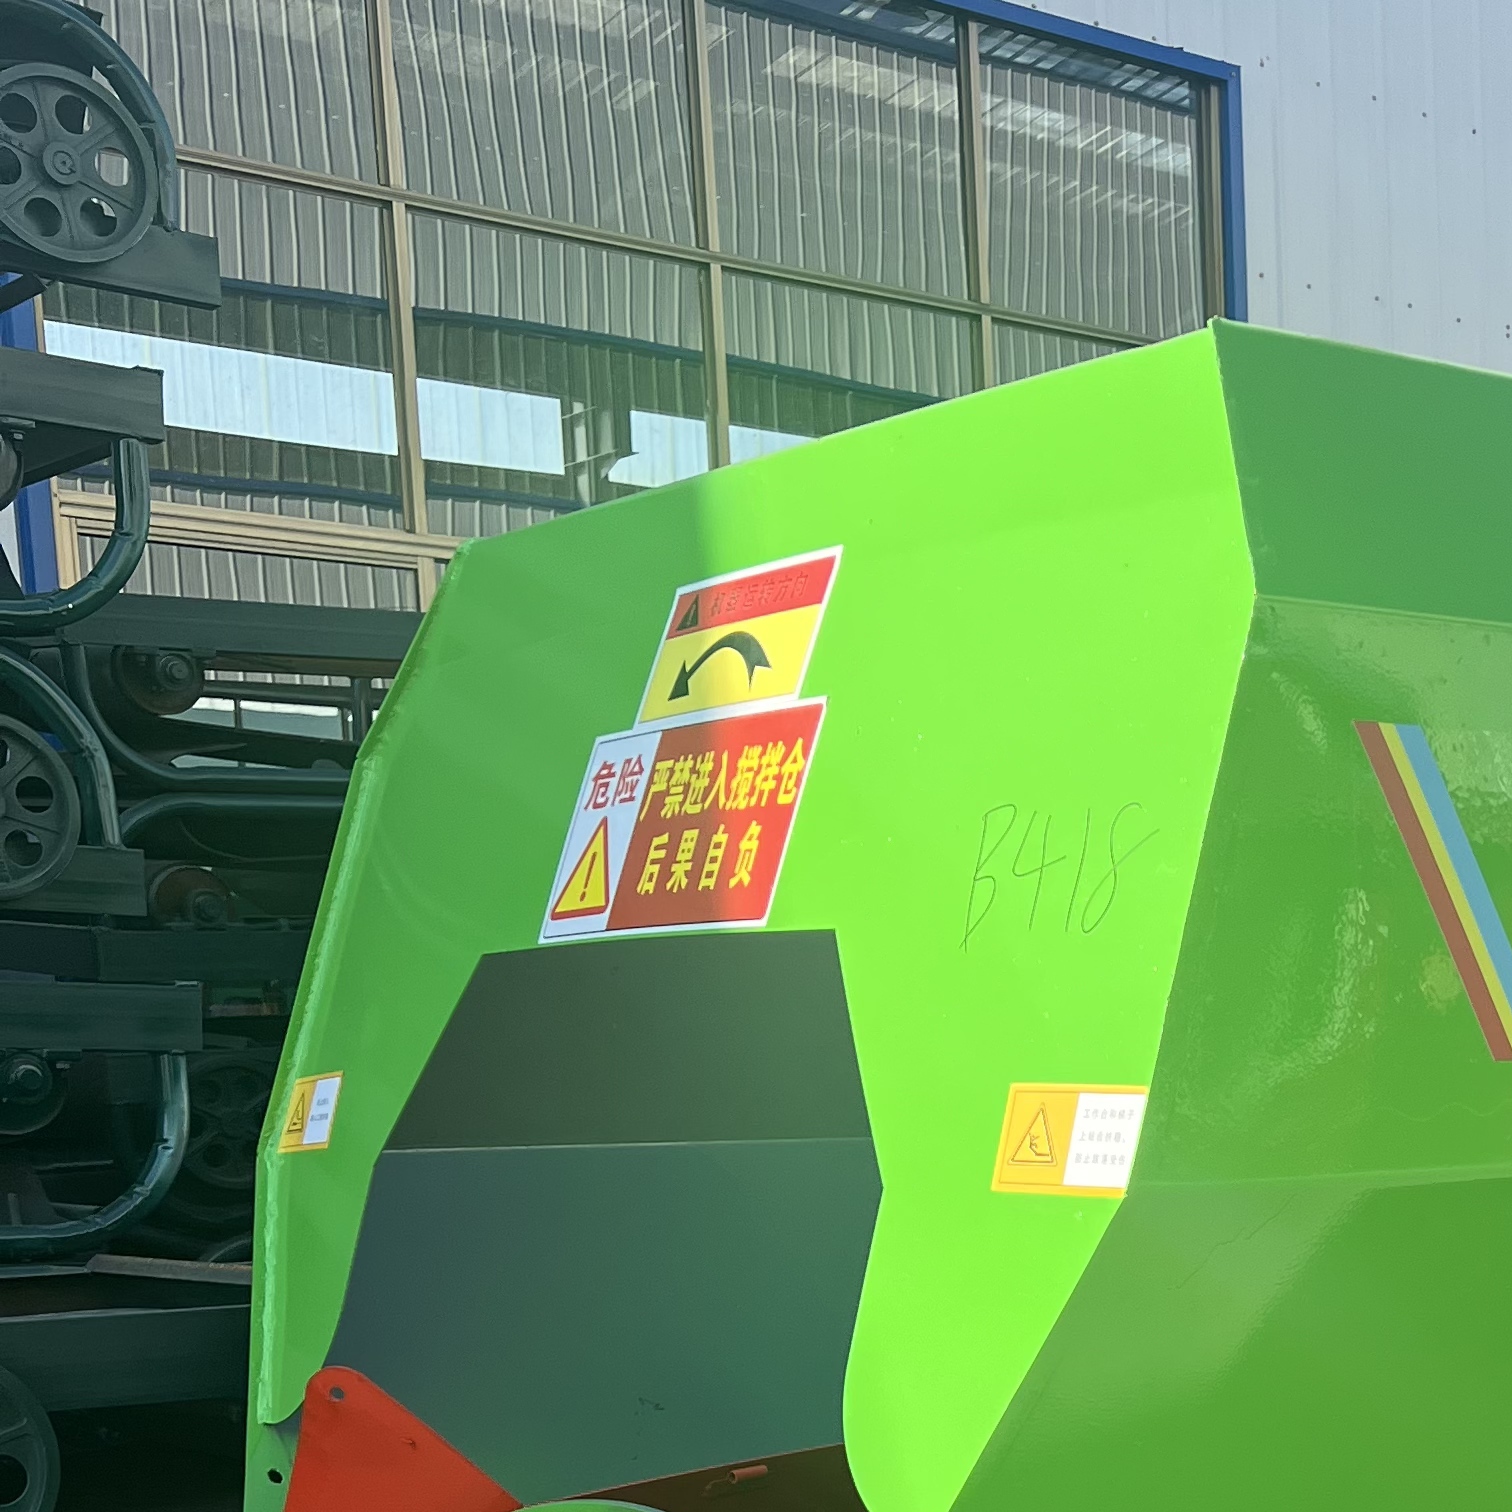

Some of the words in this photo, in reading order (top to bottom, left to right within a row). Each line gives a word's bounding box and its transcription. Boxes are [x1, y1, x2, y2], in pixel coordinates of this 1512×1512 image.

[584, 754, 645, 811] 危险
[639, 736, 806, 822] 严禁进入搅拌仓
[636, 820, 763, 896] 后果自负
[958, 802, 1160, 954] B418
